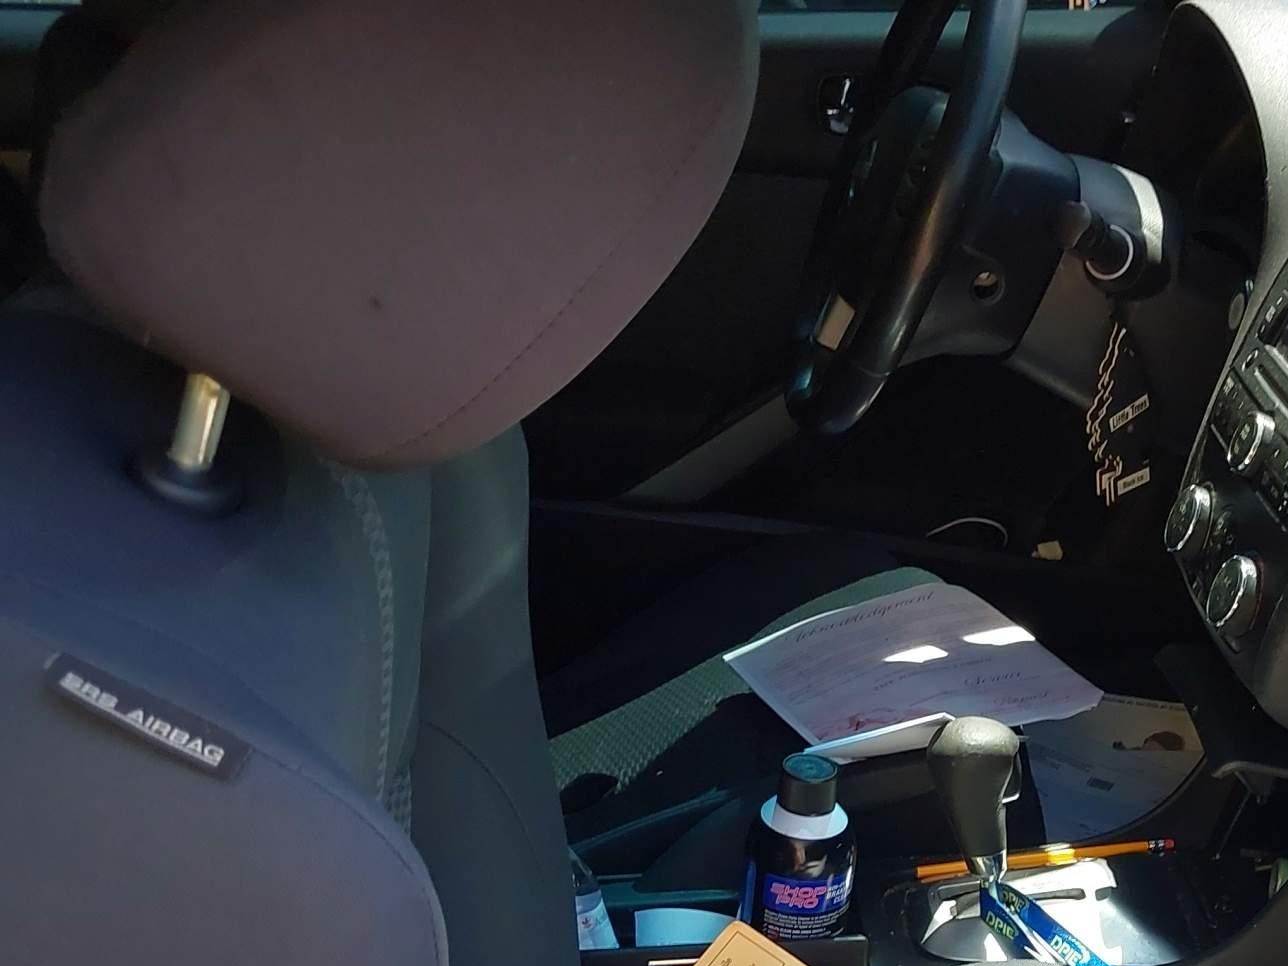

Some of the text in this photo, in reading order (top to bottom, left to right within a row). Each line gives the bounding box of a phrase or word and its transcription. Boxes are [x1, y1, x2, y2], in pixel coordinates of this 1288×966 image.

[1112, 399, 1148, 428] Little Trees
[121, 709, 225, 766] AIRBAG
